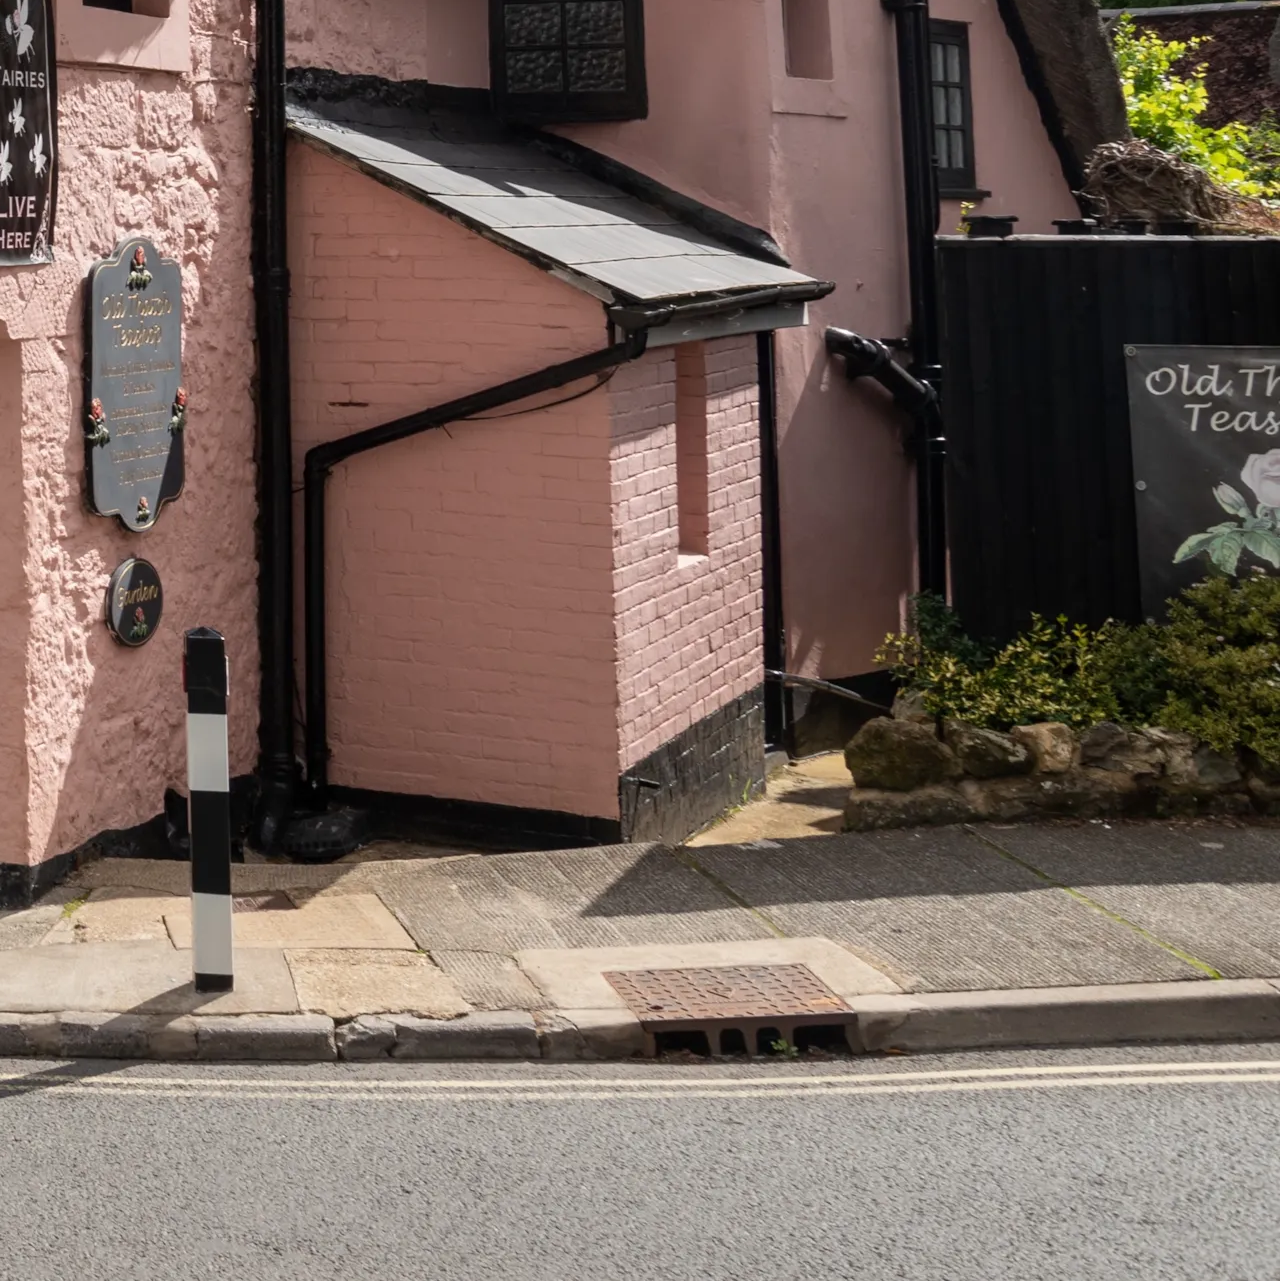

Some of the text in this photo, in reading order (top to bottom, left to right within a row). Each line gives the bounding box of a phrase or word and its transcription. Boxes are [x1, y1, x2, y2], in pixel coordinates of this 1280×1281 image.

[102, 293, 127, 321] Old
[1145, 363, 1233, 397] Old
[1183, 402, 1280, 436] Teas
[117, 579, 159, 609] Garden
